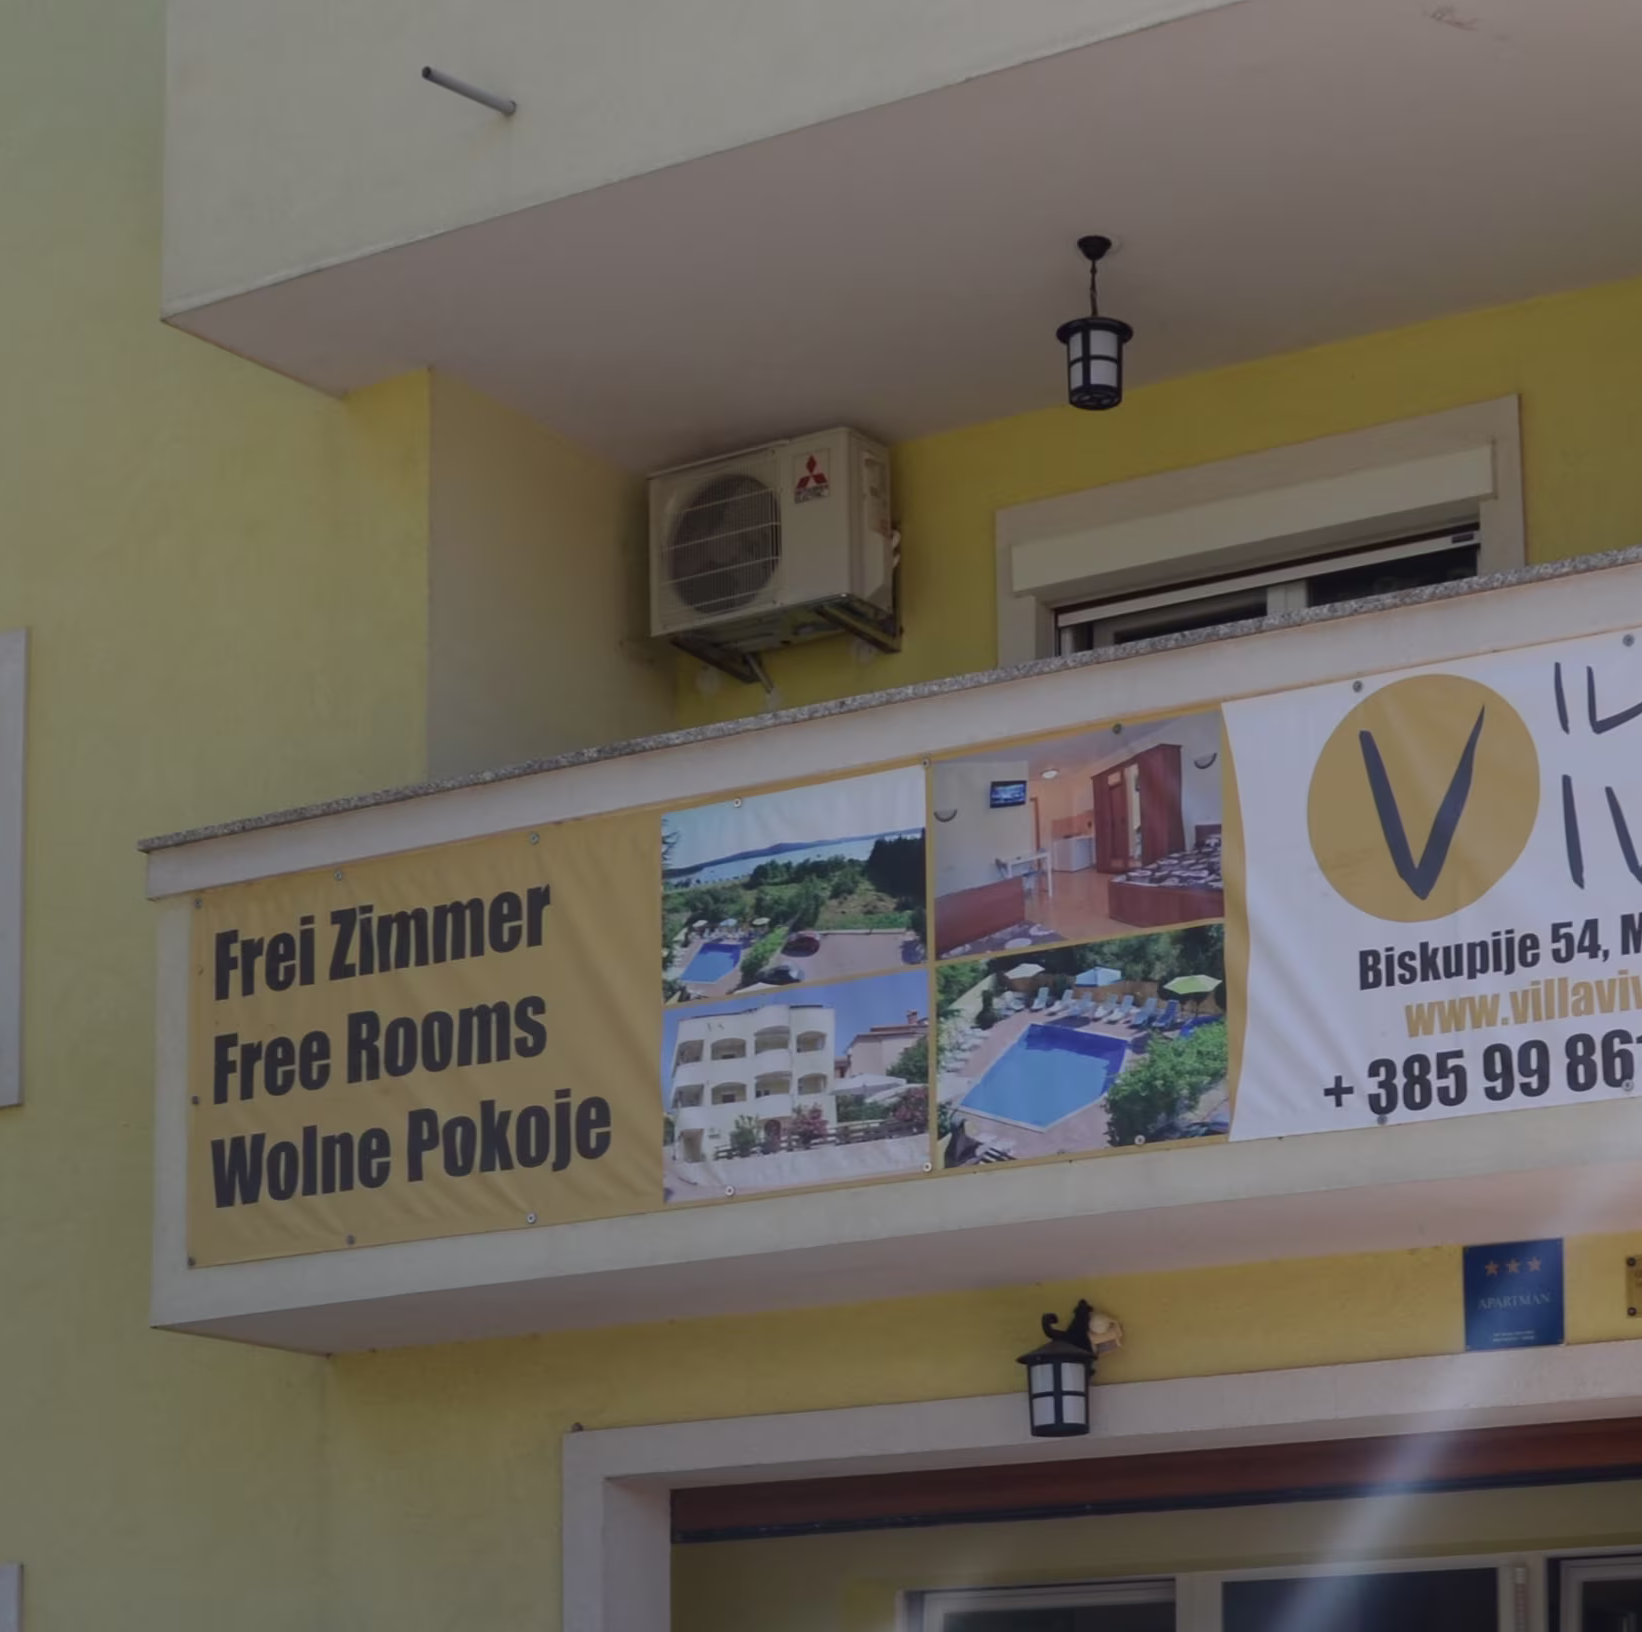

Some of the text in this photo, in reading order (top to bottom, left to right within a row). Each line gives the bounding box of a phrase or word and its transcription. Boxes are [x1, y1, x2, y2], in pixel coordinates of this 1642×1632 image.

[215, 884, 550, 1000] Frei Zimmer
[1359, 929, 1540, 990] Biskupije
[1552, 919, 1609, 963] 54,
[214, 996, 546, 1104] Free Rooms
[1483, 1040, 1549, 1101] 99
[211, 1088, 611, 1208] Wolne Pokoje
[1477, 1293, 1552, 1310] APARTMAN
